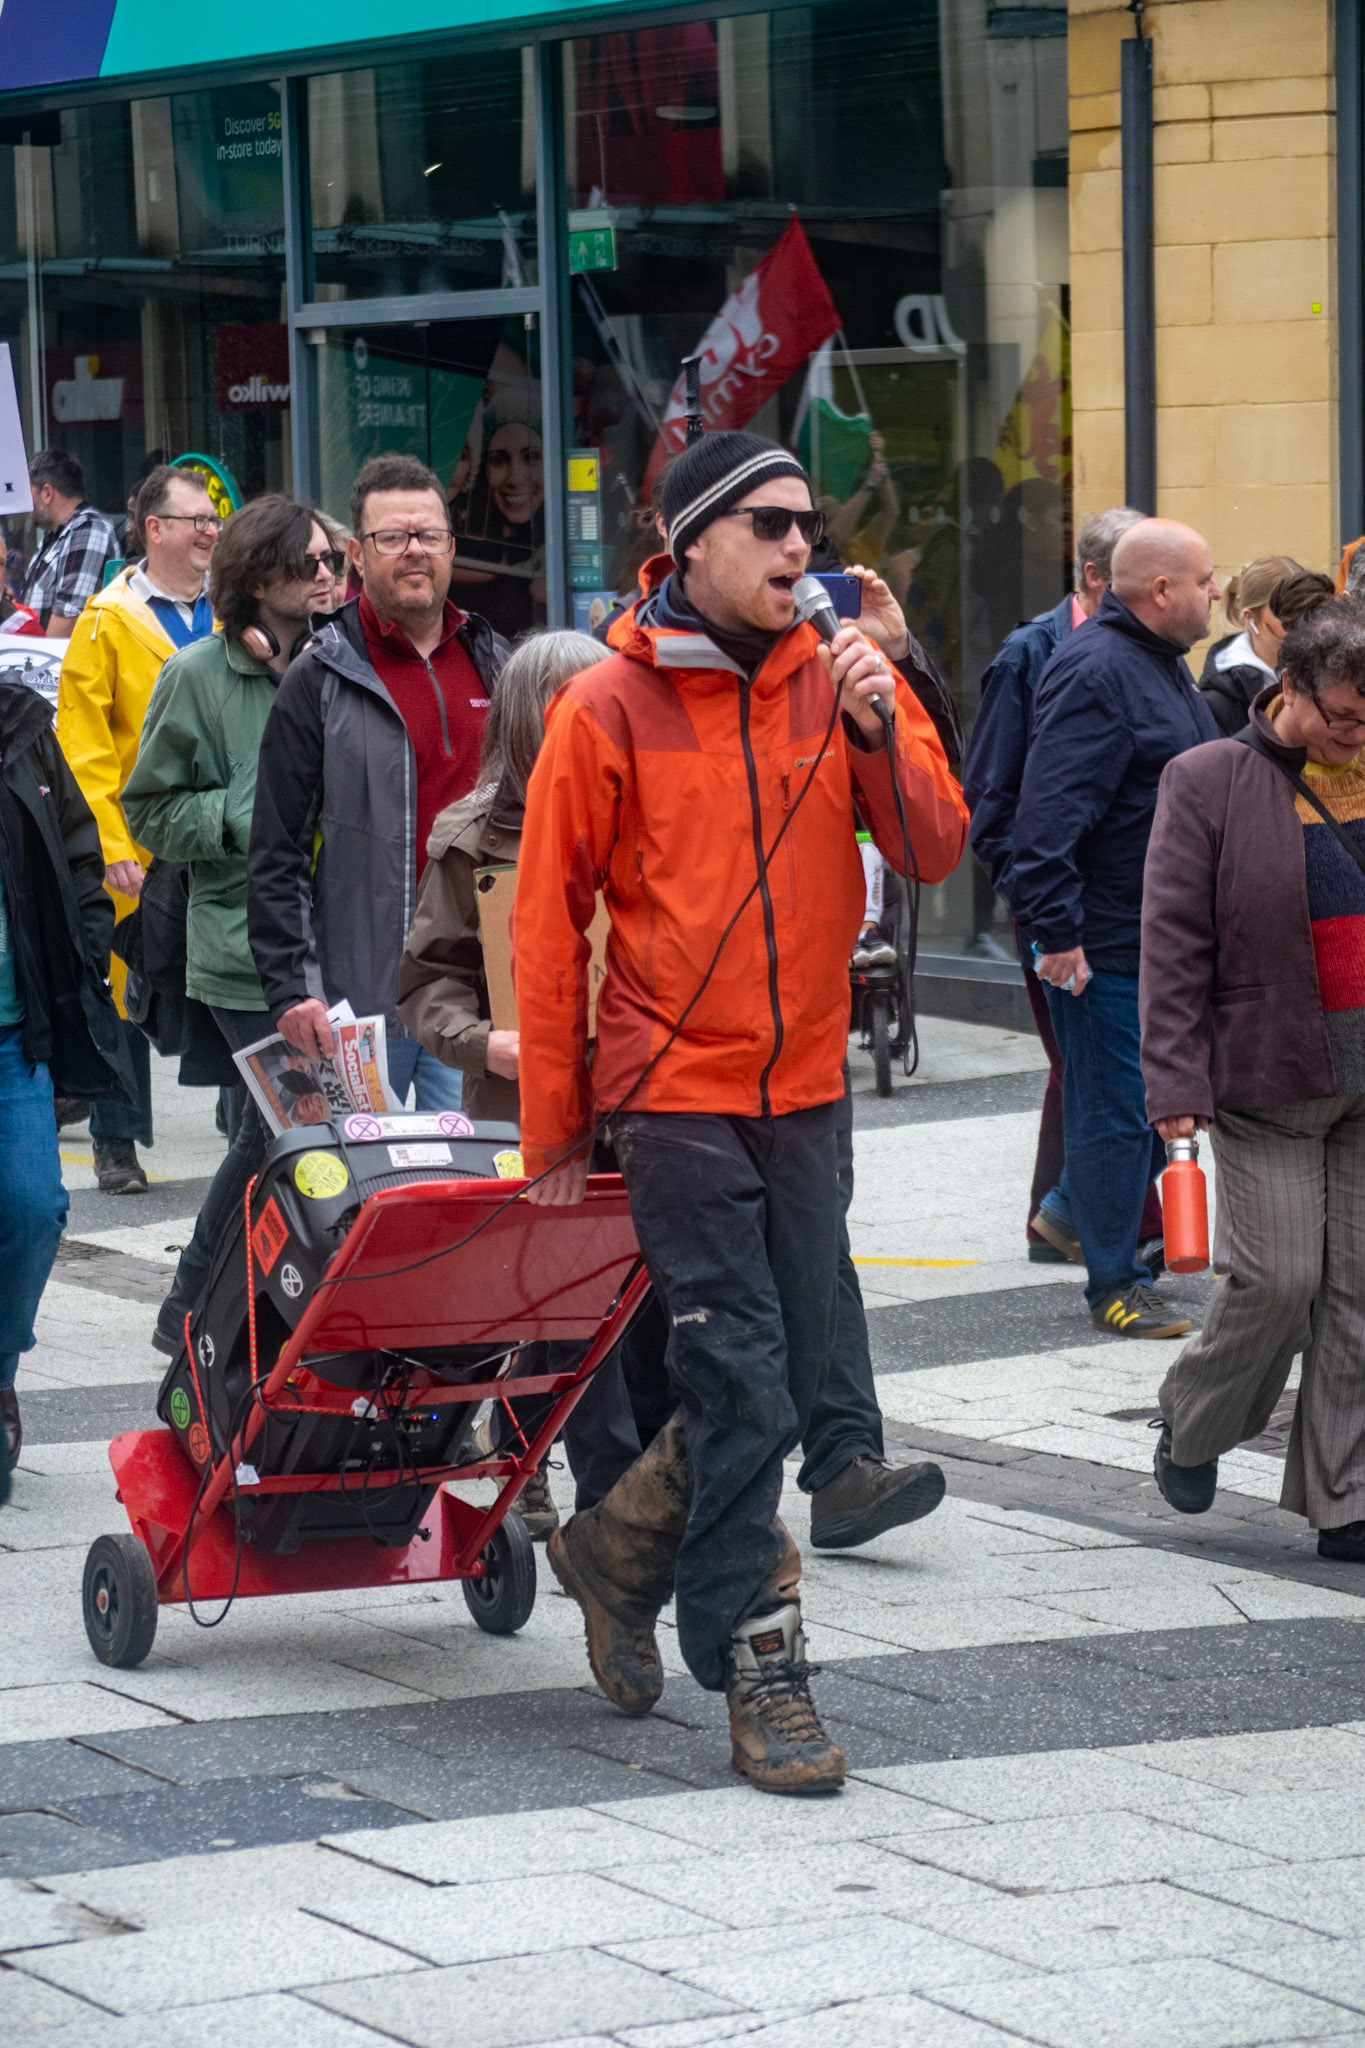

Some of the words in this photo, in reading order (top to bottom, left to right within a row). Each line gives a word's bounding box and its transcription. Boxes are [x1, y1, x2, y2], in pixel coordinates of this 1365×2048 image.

[225, 117, 266, 136] Discover
[267, 111, 282, 131] 5G
[216, 141, 253, 160] in-store
[254, 136, 282, 158] today
[344, 1038, 371, 1110] Socialist
